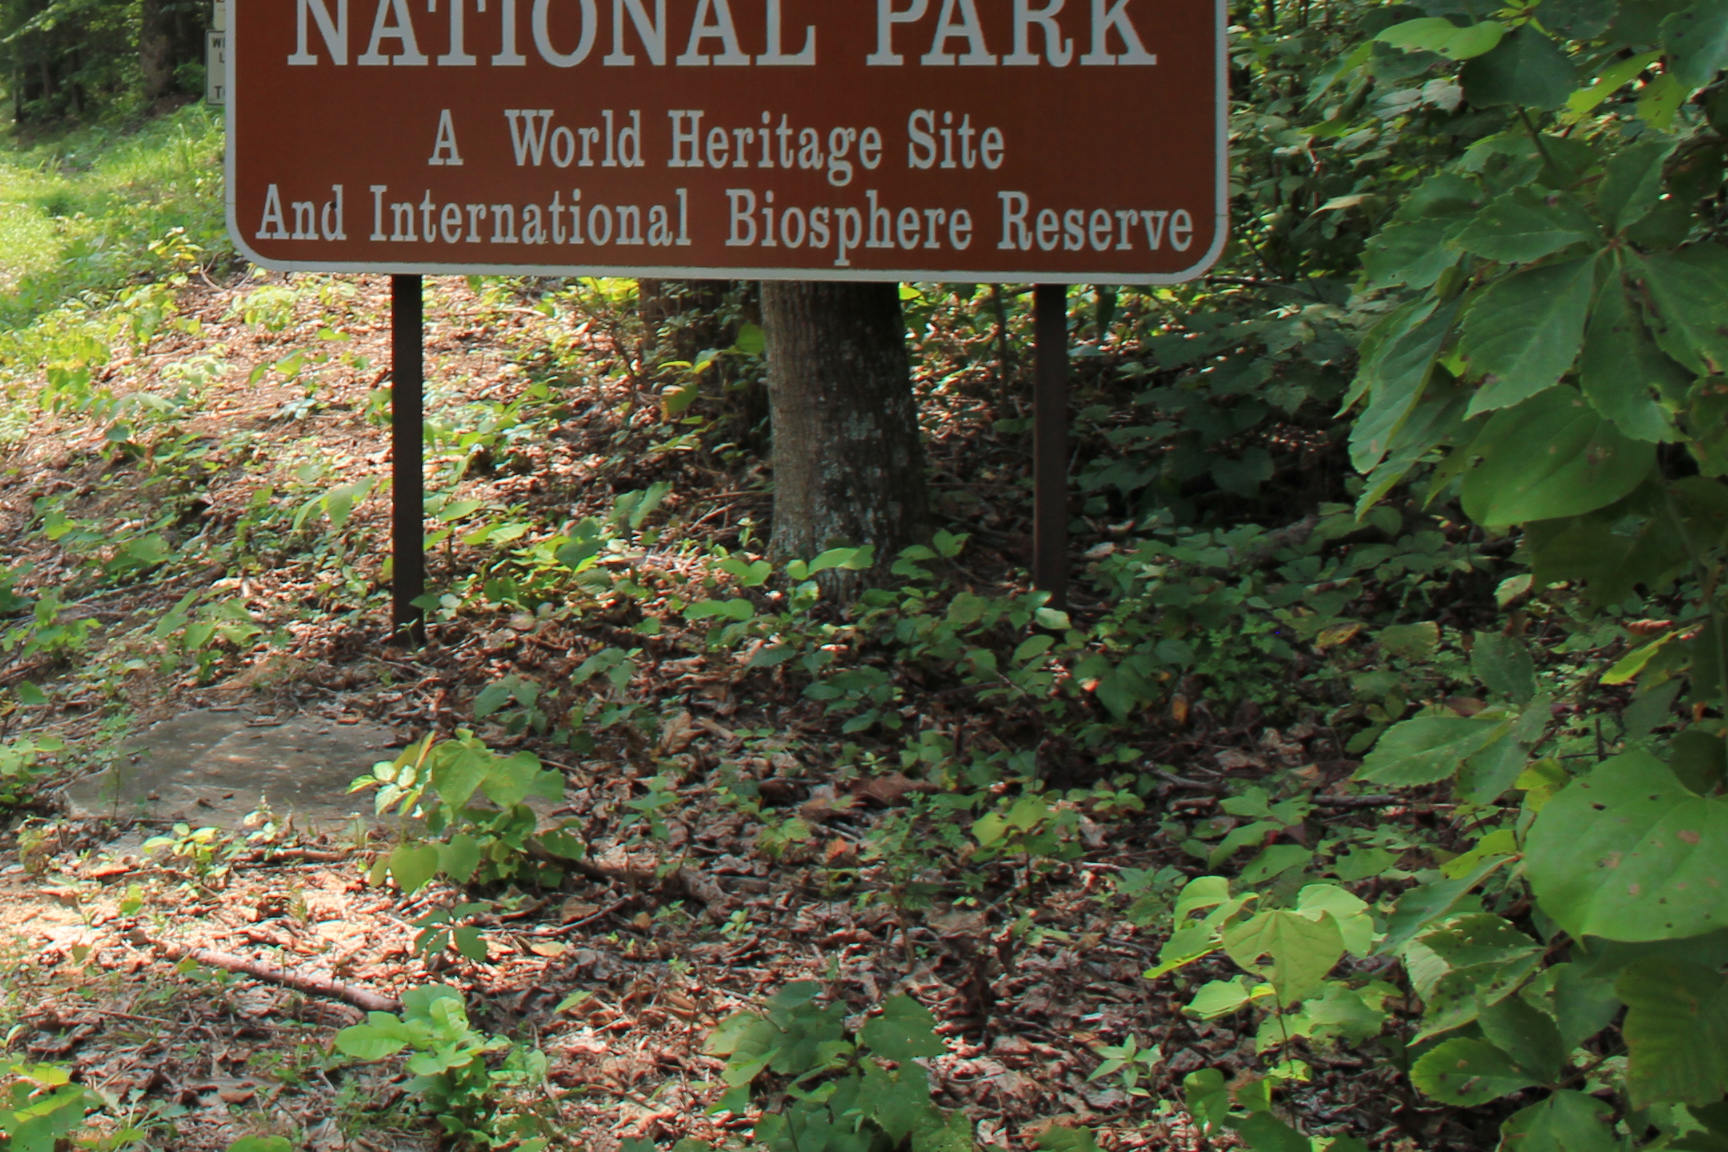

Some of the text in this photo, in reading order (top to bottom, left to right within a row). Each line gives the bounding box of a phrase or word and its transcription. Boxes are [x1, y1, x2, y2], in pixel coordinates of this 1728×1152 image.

[428, 109, 1005, 187] A World Heritage Site
[255, 183, 1193, 267] And International Biosphere Reserve
